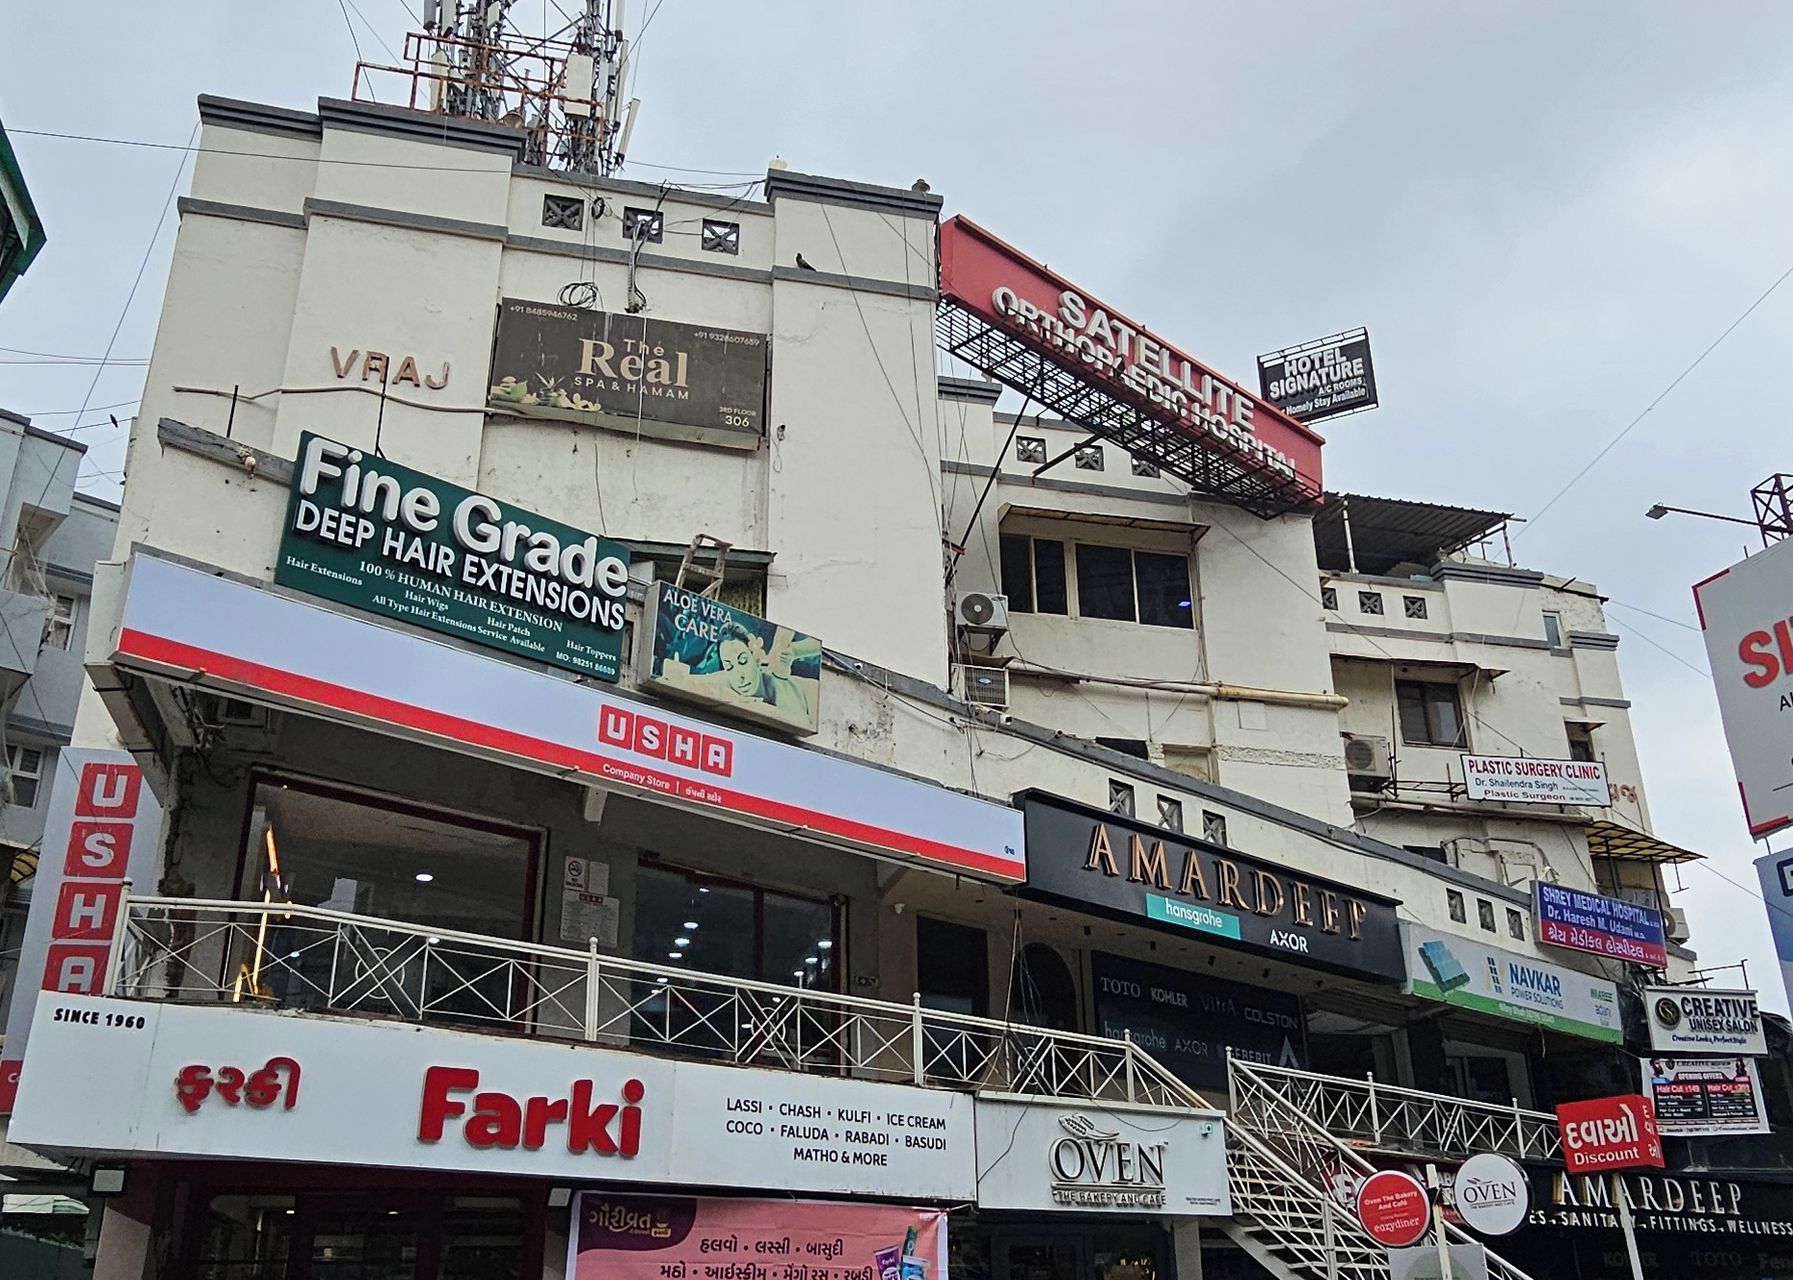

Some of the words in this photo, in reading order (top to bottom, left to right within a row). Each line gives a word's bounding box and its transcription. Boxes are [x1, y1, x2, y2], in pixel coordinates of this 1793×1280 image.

[623, 338, 666, 357] The
[1057, 290, 1255, 432] SATELLITE
[330, 346, 451, 391] VRAJ
[578, 338, 690, 388] Real
[1284, 348, 1347, 377] HOTEL
[573, 376, 606, 391] SPA
[611, 383, 620, 392] &
[627, 385, 690, 401] HAMAM
[1269, 358, 1364, 400] SIGNATURE
[1333, 377, 1362, 394] ROOMS
[1286, 401, 1313, 416] Homely
[1314, 396, 1331, 409] Stay
[1332, 387, 1366, 404] Available
[725, 415, 749, 428] 306
[300, 436, 441, 533] Fine
[452, 494, 629, 598] Grade
[286, 556, 309, 570] Hair
[310, 563, 363, 586] Extensions
[293, 499, 375, 549] DEEP
[381, 527, 455, 578] HAIR
[459, 554, 625, 631] EXTENSIONS
[360, 561, 382, 577] 100
[384, 568, 396, 581] %
[398, 572, 451, 598] HUMAN
[453, 589, 487, 609] HAIR
[489, 601, 563, 633] EXTENSION
[405, 590, 426, 604] Hair
[427, 596, 449, 611] Wigs
[663, 589, 698, 613] ALOE
[702, 601, 733, 625] VERA
[372, 595, 386, 606] All
[387, 598, 409, 613] Type
[410, 605, 431, 618] Hair
[431, 609, 477, 632] Extensions
[477, 625, 508, 642] Service
[510, 635, 546, 653] Available
[487, 616, 507, 630] Hair
[508, 622, 531, 637] Patch
[674, 612, 718, 643] CARE
[566, 640, 585, 652] Hair
[585, 645, 617, 662] Toppers
[607, 712, 726, 770] USHA
[603, 763, 645, 784] Company
[647, 776, 670, 790] Store
[1468, 759, 1513, 776] PLASTIC
[1515, 763, 1562, 778] SURGERY
[1565, 766, 1601, 780] CLINIC
[1475, 777, 1488, 787] Dr.
[1489, 778, 1533, 789] Shailendra
[1535, 781, 1559, 792] Singh
[1484, 789, 1519, 799] Plastic
[1522, 791, 1566, 801] Surgeon
[57, 773, 128, 993] USHA
[1081, 823, 1368, 942] AMARDEEP
[1165, 897, 1223, 929] hansgrohe
[1543, 886, 1571, 907] SHREY
[1572, 893, 1611, 916] MEDICAL
[1612, 901, 1650, 926] HOSPITAL
[1548, 905, 1561, 920] Dr.
[1563, 909, 1596, 928] Haresh
[1598, 916, 1608, 930] M.
[1610, 919, 1633, 937] Udani
[1269, 929, 1309, 954] AXOR
[1571, 927, 1602, 949] મેડીકલ
[1606, 935, 1645, 957] હોસ્પીટલ
[1509, 963, 1562, 997] NAVKAR
[1101, 977, 1141, 998] TOTO
[1150, 986, 1189, 1008] KOHLER
[1244, 1007, 1298, 1029] COLSTON
[1511, 987, 1533, 1002] POWER
[1680, 997, 1760, 1019] CREATIVE
[54, 1008, 99, 1025] SINCE
[106, 1013, 146, 1029] 1960
[1689, 1018, 1725, 1032] UNISEX
[1726, 1021, 1758, 1033] SALON
[1175, 1039, 1208, 1056] AXOR
[1672, 1034, 1695, 1042] Creative
[175, 1057, 302, 1115] ફરકી
[417, 1065, 646, 1159] Farki
[727, 1098, 762, 1113] LASSI
[779, 1103, 821, 1118] CHASH
[837, 1108, 871, 1123] KULFI
[887, 1113, 904, 1126] ICE
[907, 1115, 946, 1130] CREAM
[726, 1120, 763, 1135] COCO
[780, 1125, 829, 1141] FALUDA
[845, 1131, 889, 1146] RABADI
[905, 1136, 947, 1150] BASUDI
[1565, 1104, 1639, 1149] દવાઓ
[793, 1148, 838, 1163] MATHO
[841, 1151, 850, 1163] &
[853, 1153, 888, 1166] MORE
[1049, 1137, 1167, 1185] OVEN
[1574, 1146, 1640, 1165] Discount
[1053, 1190, 1076, 1203] THE
[1078, 1191, 1117, 1204] BAKERY
[1120, 1192, 1140, 1205] AND
[1364, 1198, 1382, 1206] Oven
[1382, 1194, 1395, 1202] The
[1395, 1190, 1418, 1200] Bakery
[1378, 1202, 1393, 1210] And
[1463, 1181, 1516, 1203] OVEN
[1374, 1217, 1420, 1234] eazydiner
[1651, 1215, 1716, 1233] FITTINGS
[1727, 1220, 1793, 1236] WELLNESS
[700, 1235, 737, 1253] હલવો
[755, 1239, 790, 1255] લસ્સી
[806, 1239, 843, 1257] બાસુદી
[660, 1260, 686, 1279] મઠો
